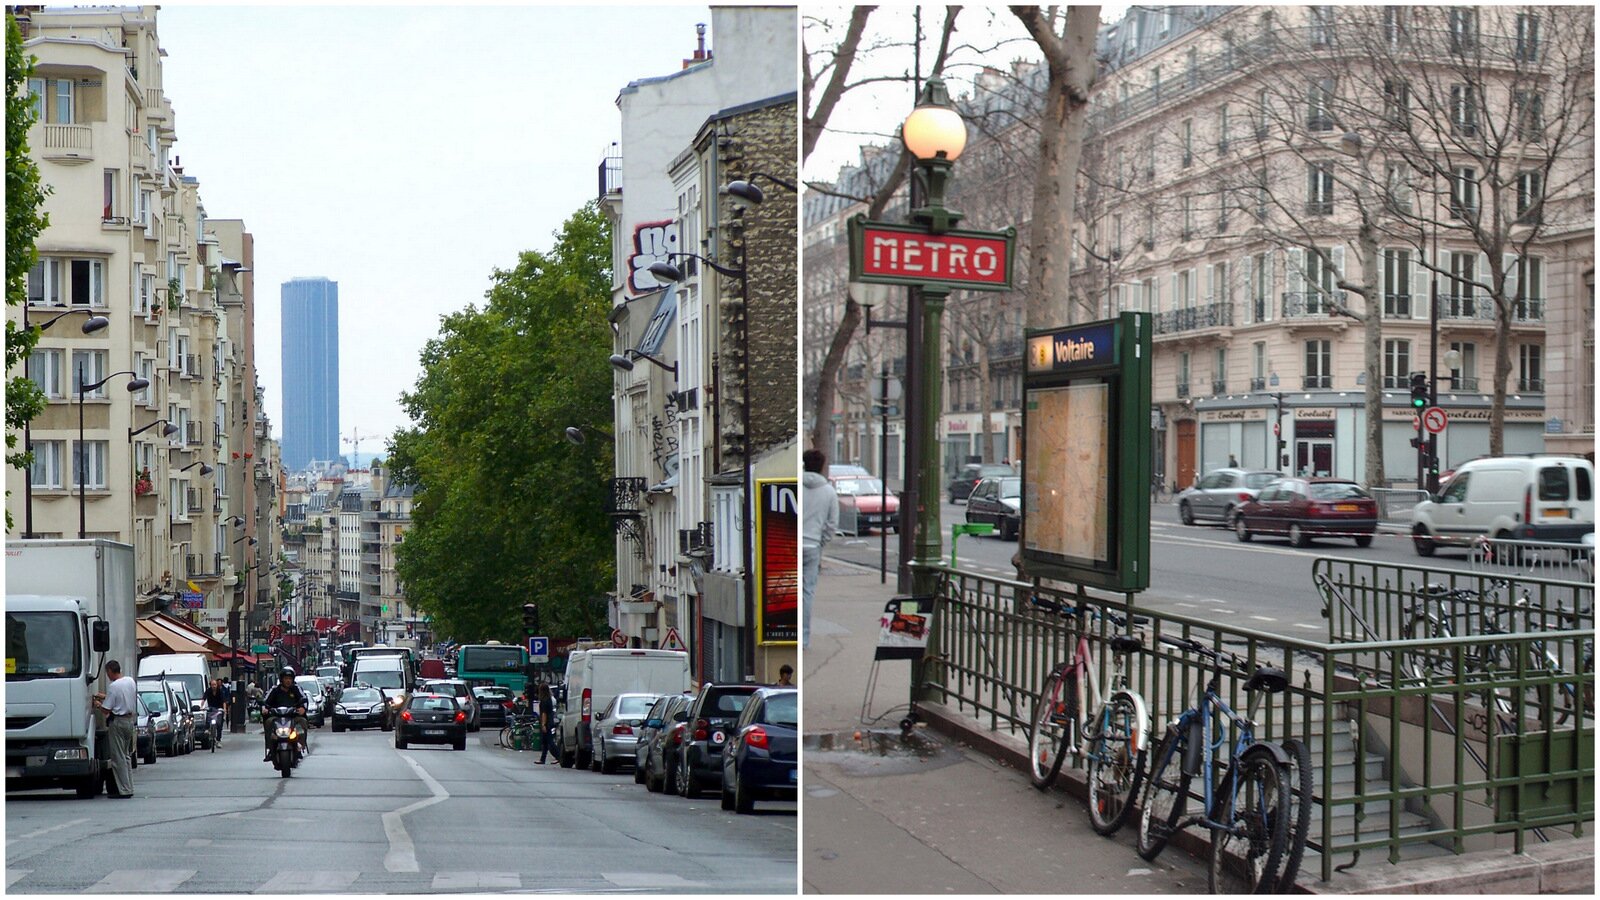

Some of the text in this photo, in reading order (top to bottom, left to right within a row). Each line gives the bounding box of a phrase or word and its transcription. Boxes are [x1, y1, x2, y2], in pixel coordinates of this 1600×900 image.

[873, 237, 997, 276] METRO
[1055, 336, 1095, 363] Voltaire
[1297, 408, 1333, 419] Evolutif
[1445, 409, 1493, 421] volutif
[534, 641, 543, 653] P
[716, 733, 723, 742] A
